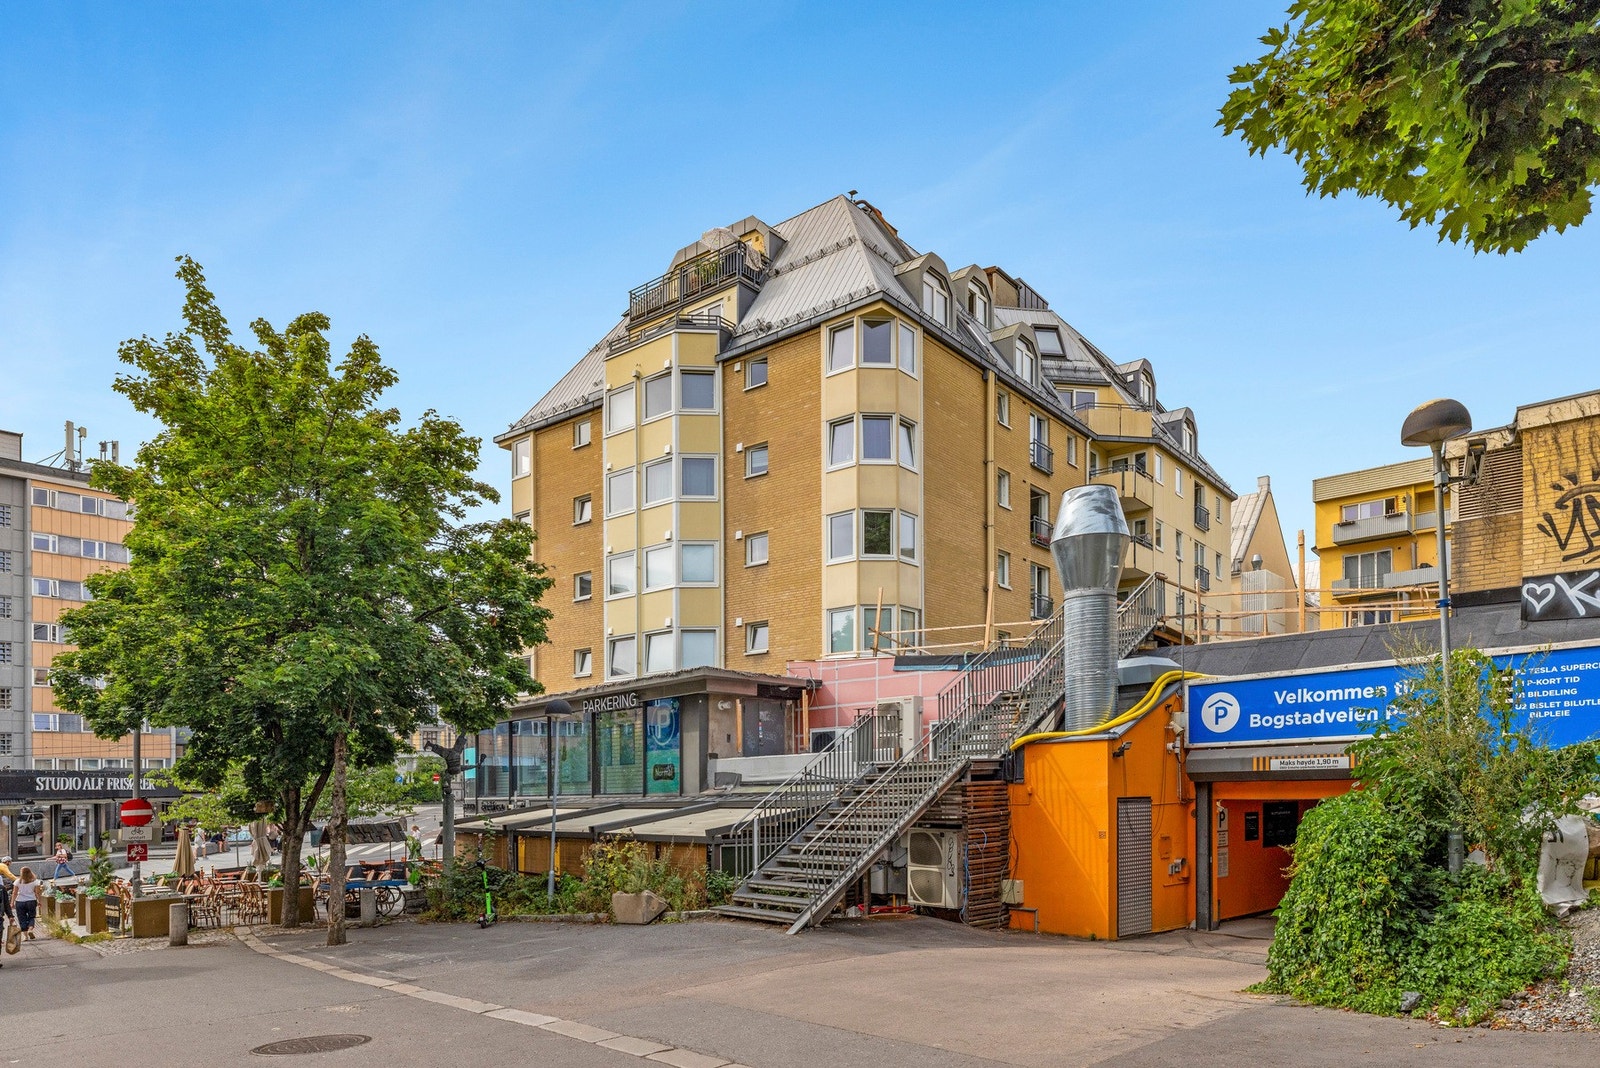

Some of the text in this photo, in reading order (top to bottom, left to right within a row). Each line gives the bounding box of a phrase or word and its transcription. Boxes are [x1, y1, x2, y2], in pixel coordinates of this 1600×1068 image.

[1528, 666, 1558, 674] TESLA
[1527, 677, 1562, 686] P-KORT
[1274, 686, 1387, 705] Velkommen
[1528, 688, 1578, 698] BILDELING
[583, 692, 637, 714] PARKERING
[1529, 701, 1562, 709] BISLET
[1215, 706, 1228, 725] P
[1250, 706, 1378, 729] Bogstadveien
[1529, 709, 1571, 718] BILPLEIE
[1316, 758, 1331, 766] 1,90
[35, 776, 80, 791] STUDIO
[83, 777, 104, 790] ALF
